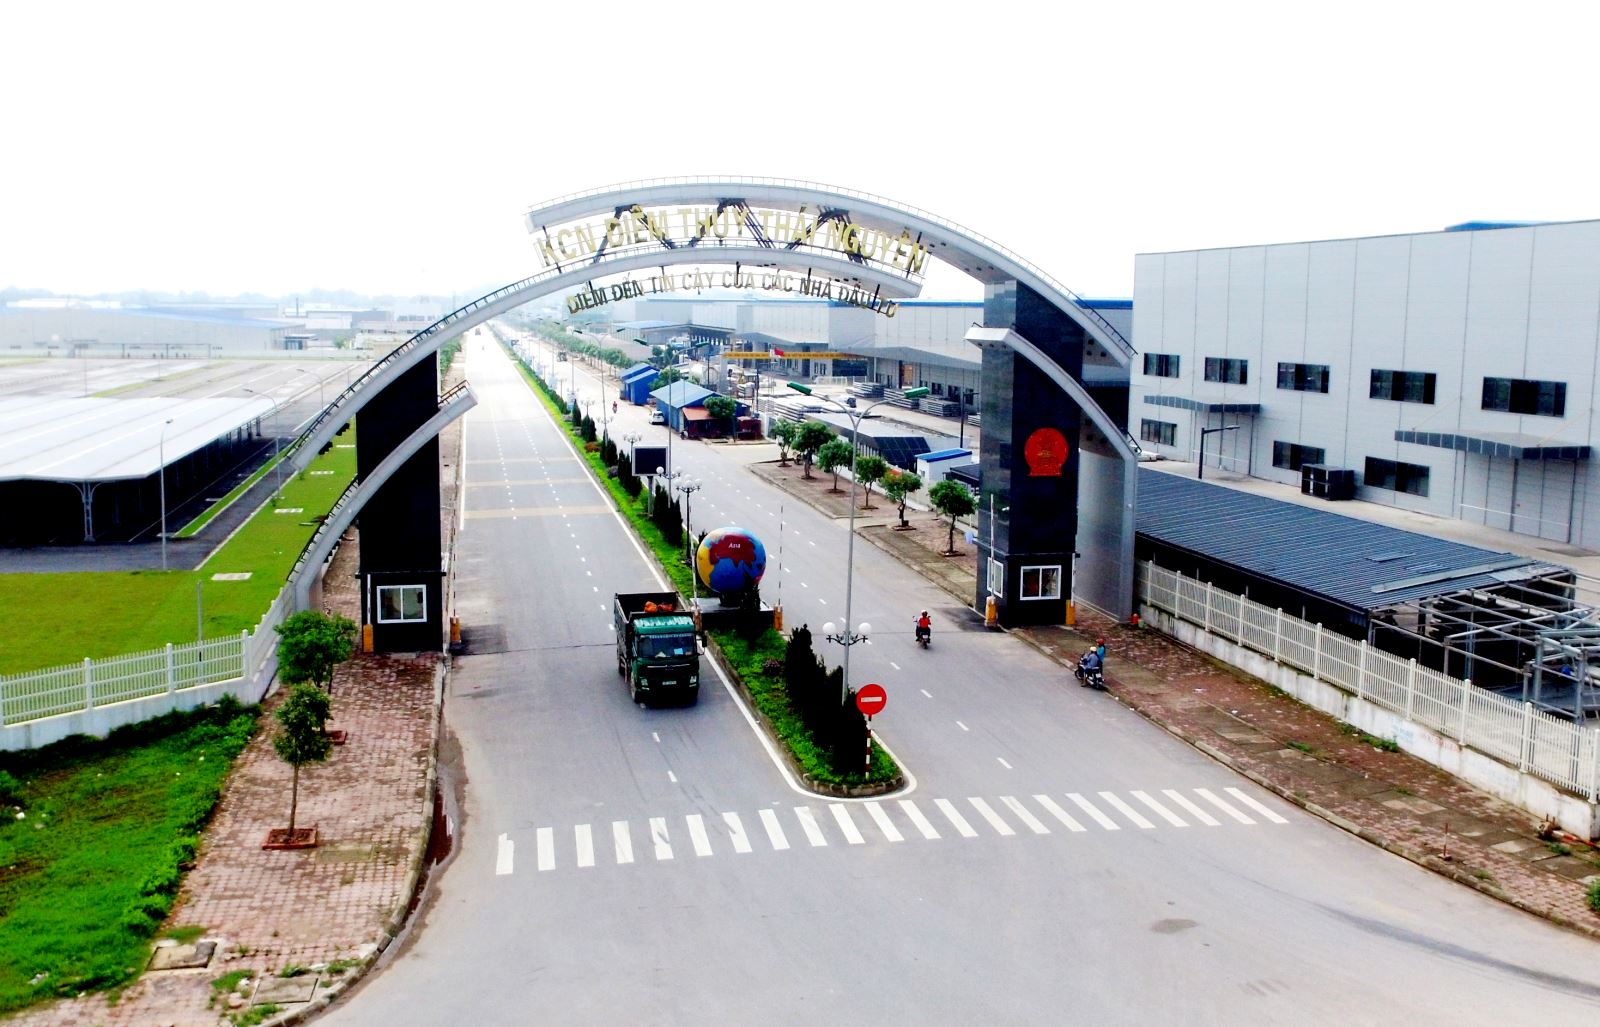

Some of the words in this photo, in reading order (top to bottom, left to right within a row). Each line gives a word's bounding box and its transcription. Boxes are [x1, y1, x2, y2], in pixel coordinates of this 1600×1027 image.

[536, 223, 597, 267] KCN
[759, 205, 819, 245] THÁI
[825, 217, 928, 273] NGUYÊN
[648, 274, 676, 294] TIN
[762, 268, 794, 292] CÁC
